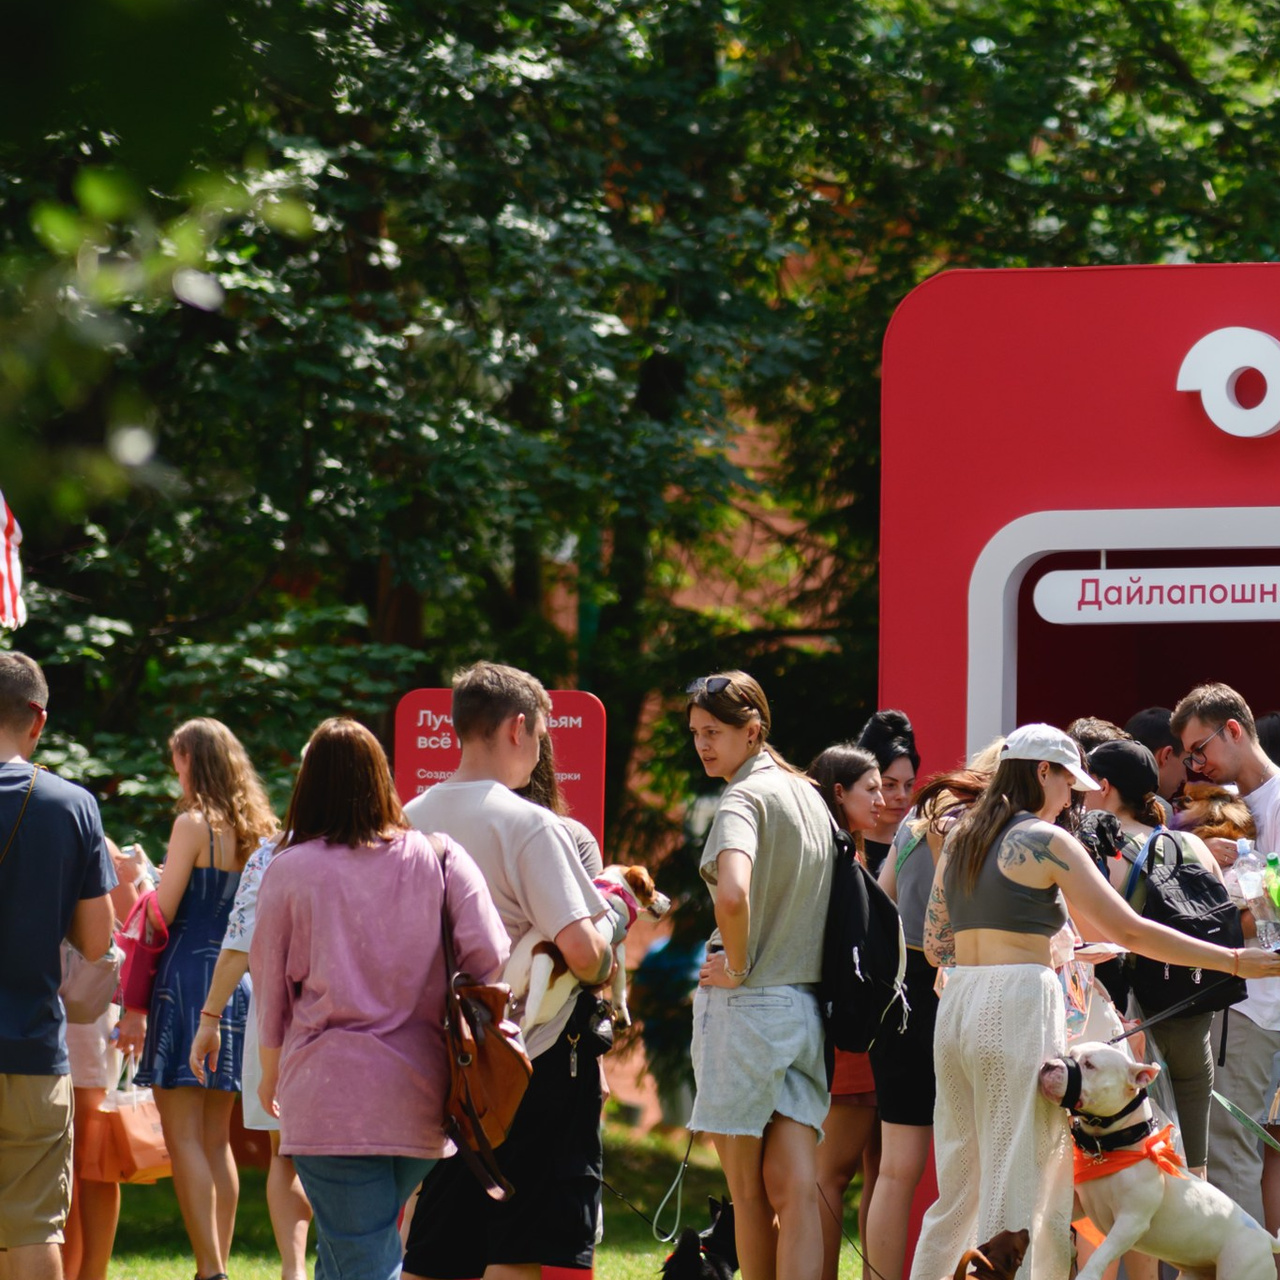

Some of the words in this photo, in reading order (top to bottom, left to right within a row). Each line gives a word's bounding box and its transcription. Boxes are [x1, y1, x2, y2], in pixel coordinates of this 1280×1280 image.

[416, 709, 454, 731] Луч
[545, 715, 583, 728] ьям
[416, 732, 452, 749] всё
